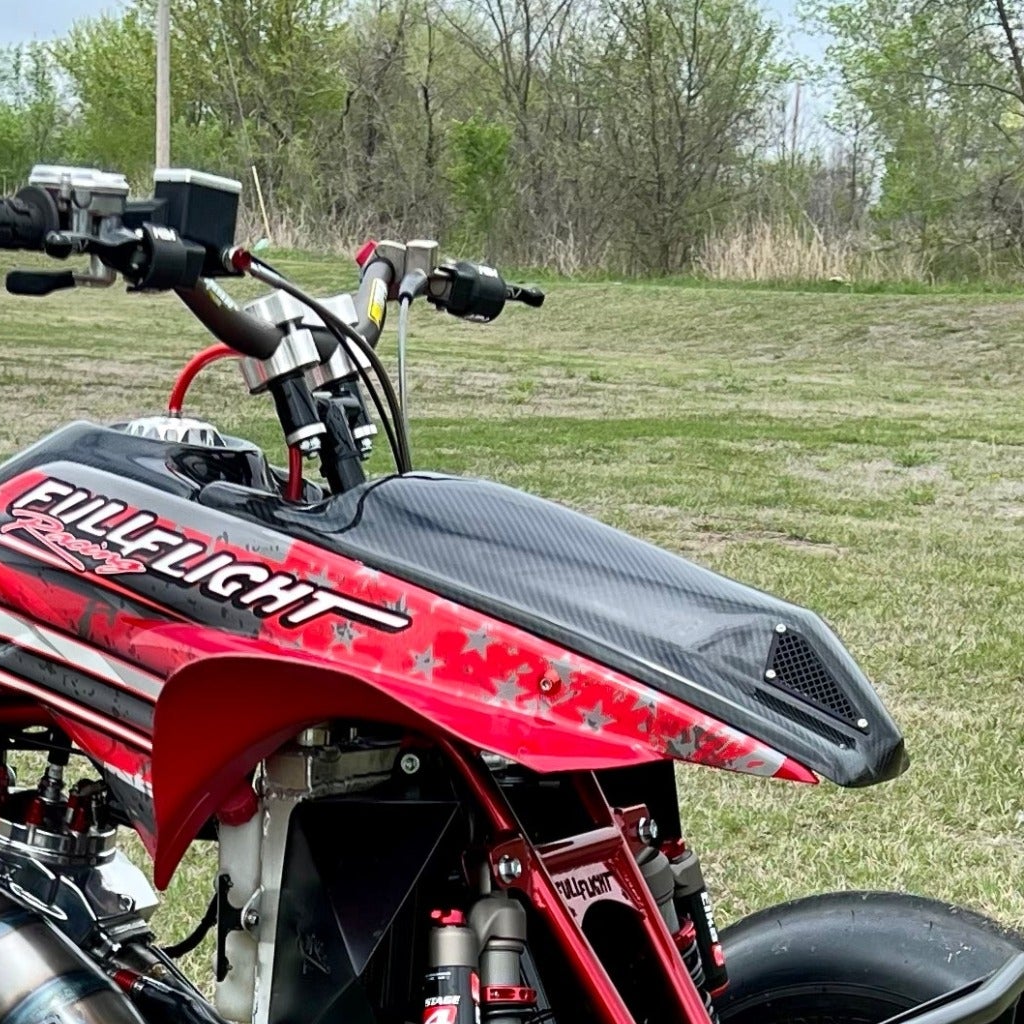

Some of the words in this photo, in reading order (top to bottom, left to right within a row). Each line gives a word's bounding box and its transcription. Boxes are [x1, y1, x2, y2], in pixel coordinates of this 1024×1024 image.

[1, 508, 146, 574] Racing
[10, 477, 411, 627] FULLFLIGHT
[425, 995, 461, 1008] STAGE
